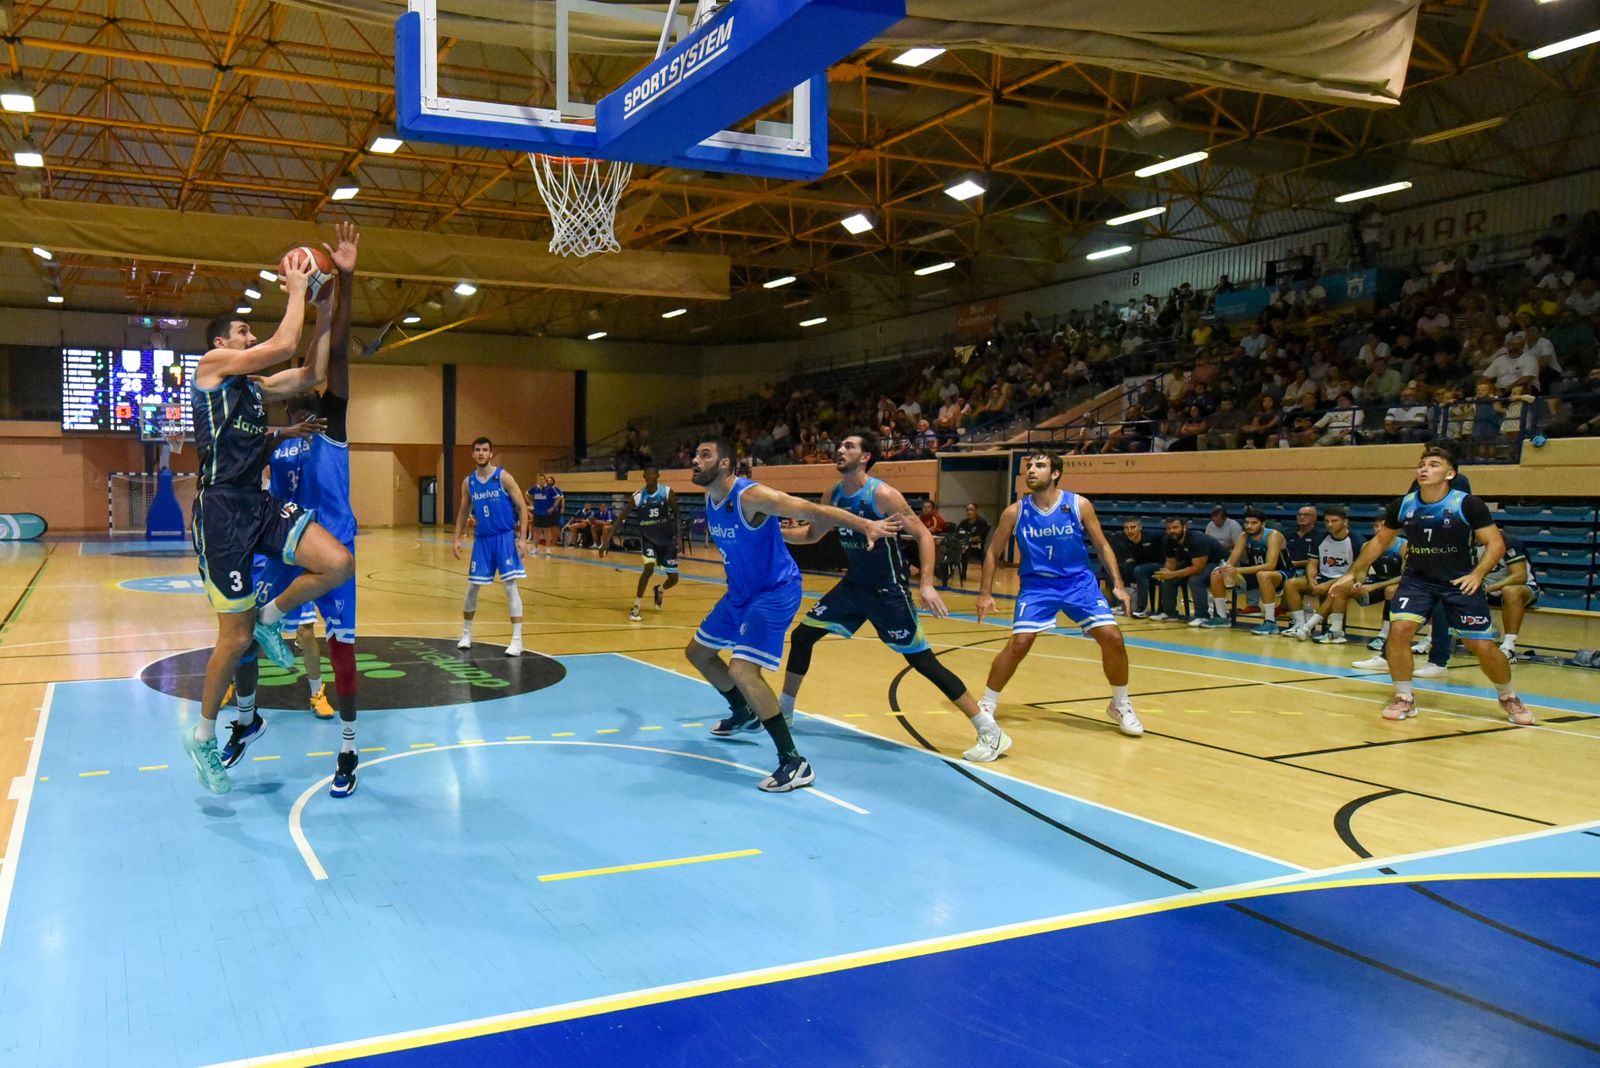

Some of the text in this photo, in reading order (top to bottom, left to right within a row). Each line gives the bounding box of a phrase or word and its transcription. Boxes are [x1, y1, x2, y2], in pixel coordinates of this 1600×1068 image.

[1132, 271, 1141, 287] B
[121, 378, 142, 392] 26
[472, 488, 501, 501] Huelva
[483, 505, 490, 518] 9
[648, 507, 660, 518] 35
[1022, 523, 1075, 539] Huelva
[1423, 528, 1433, 543] 7
[1045, 545, 1054, 560] 7
[1253, 553, 1264, 564] 14
[471, 561, 477, 573] 9
[229, 570, 243, 593] 3
[1019, 602, 1027, 616] 7
[1399, 597, 1410, 609] 7
